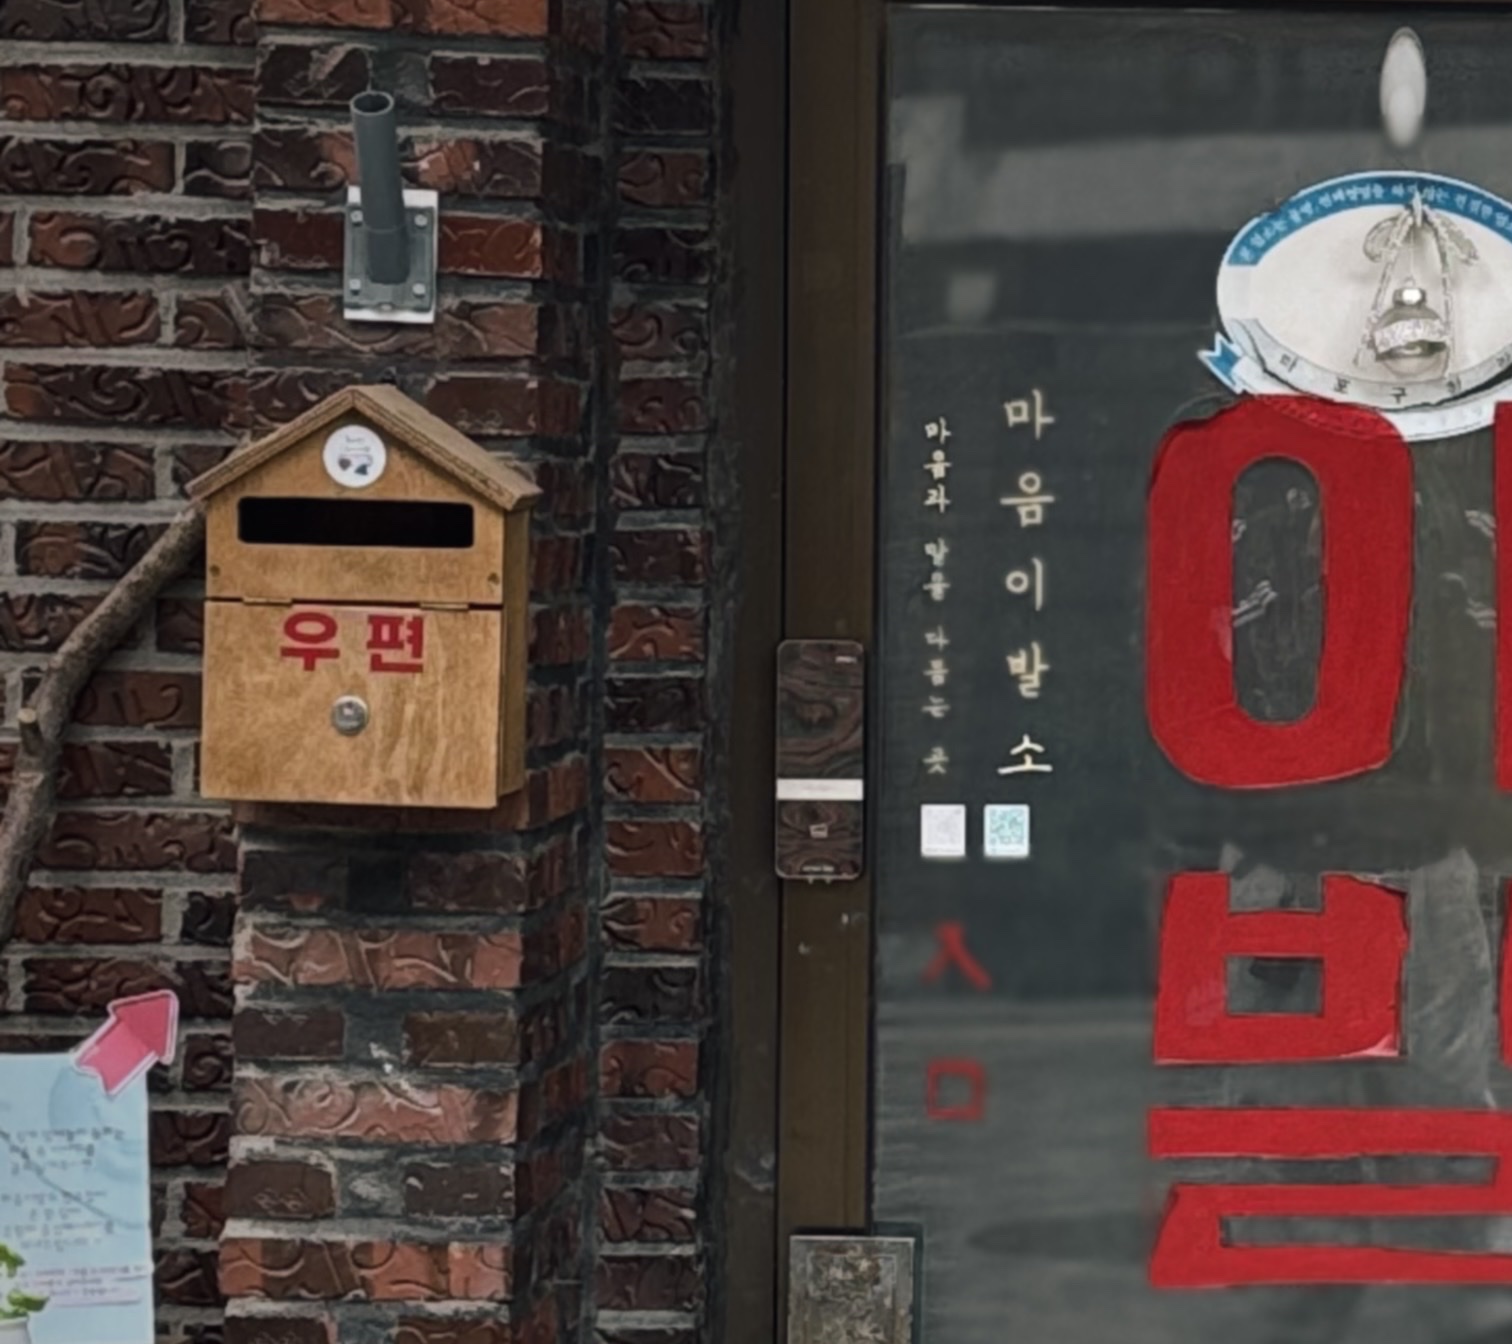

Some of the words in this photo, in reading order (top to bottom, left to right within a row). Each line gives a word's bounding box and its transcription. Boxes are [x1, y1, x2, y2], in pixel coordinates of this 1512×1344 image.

[923, 416, 952, 514] 마음과
[281, 611, 424, 674] 우편
[922, 624, 951, 719] 다듬는
[922, 746, 950, 775] 곳
